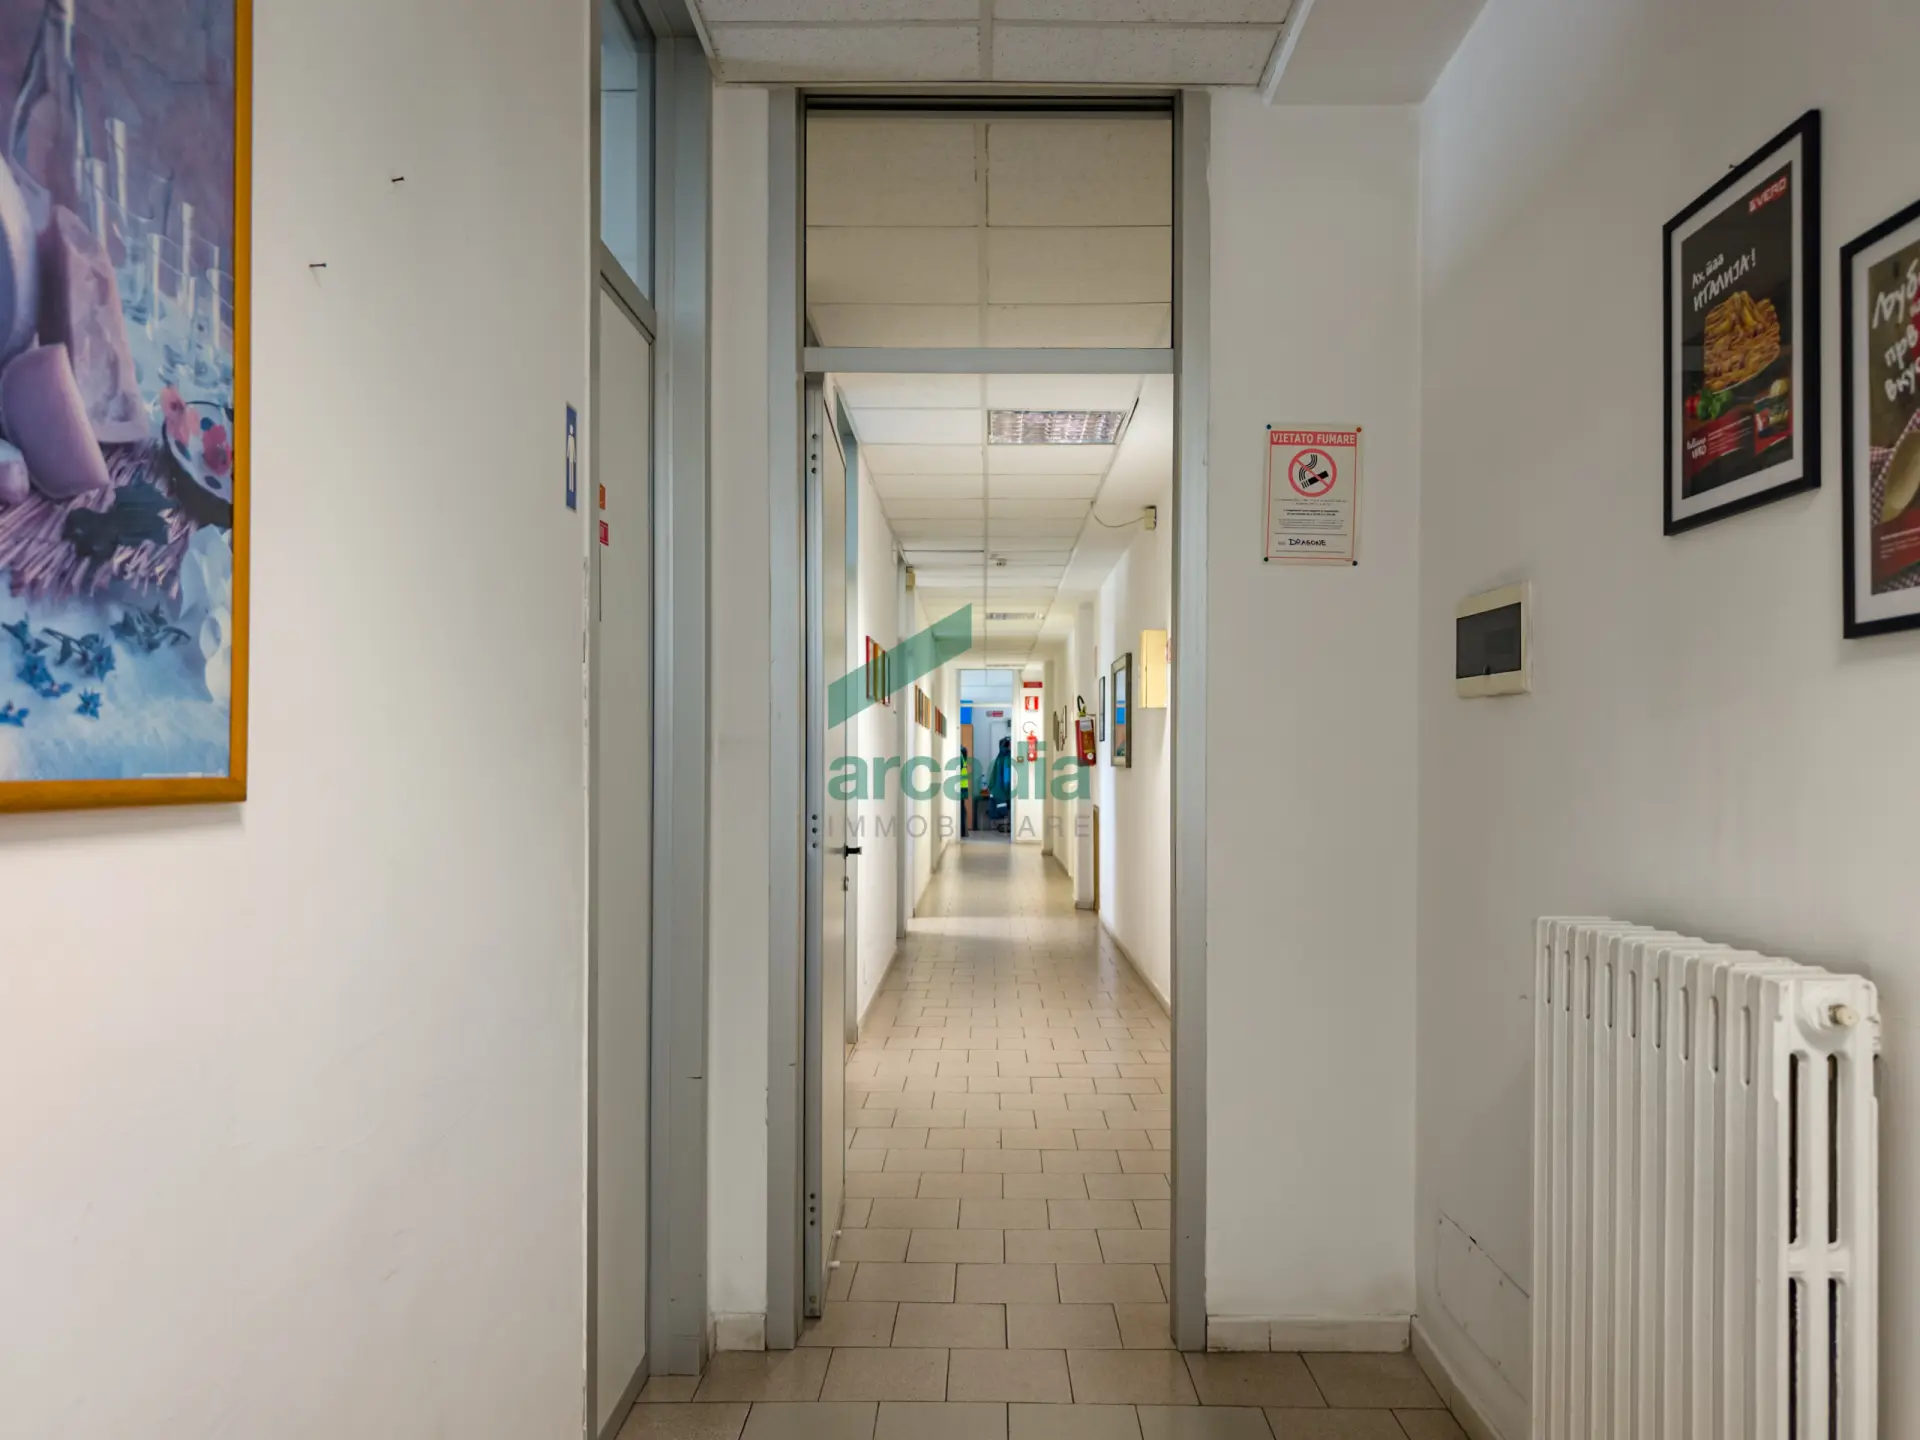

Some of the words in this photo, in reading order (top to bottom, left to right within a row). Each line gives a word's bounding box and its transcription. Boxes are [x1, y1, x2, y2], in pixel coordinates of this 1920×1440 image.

[1872, 258, 1920, 329] Љуб
[1272, 432, 1314, 444] VIETATO
[1316, 433, 1356, 445] FUMARE
